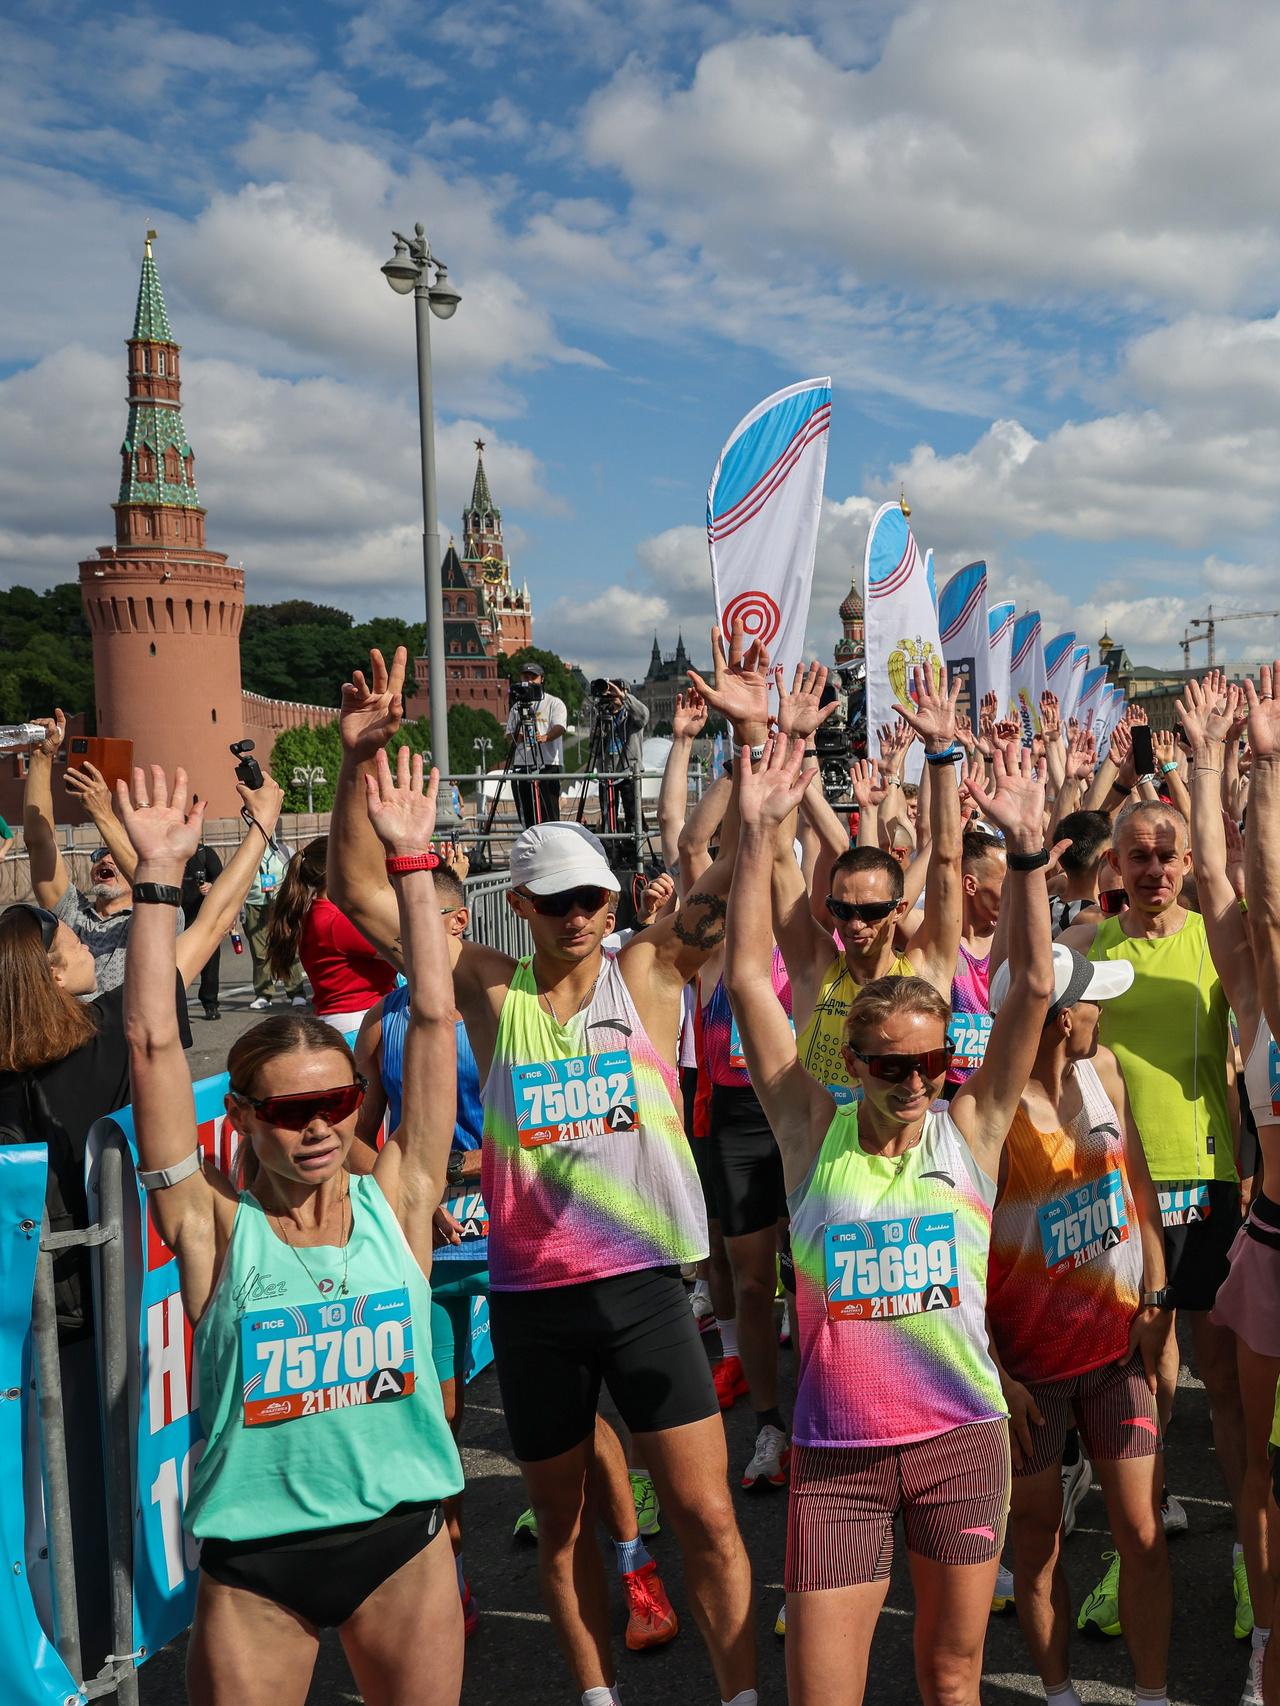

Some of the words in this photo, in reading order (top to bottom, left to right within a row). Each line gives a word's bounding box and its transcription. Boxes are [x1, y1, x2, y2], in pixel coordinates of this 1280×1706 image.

[526, 1071, 542, 1079] ПСБ
[523, 1073, 631, 1125] 75082
[558, 1117, 605, 1141] 21.1KM
[611, 1107, 632, 1128] A
[1050, 1192, 1120, 1259] 75701
[1186, 1206, 1203, 1224] A
[461, 1219, 480, 1237] A
[839, 1233, 857, 1242] ПСБ
[1104, 1228, 1121, 1250] A
[834, 1240, 951, 1297] 75699
[870, 1292, 922, 1318] 21.1KM
[926, 1286, 949, 1310] A
[262, 1319, 285, 1330] ПСБ
[256, 1320, 405, 1394] 75700
[372, 1370, 402, 1399] A
[301, 1380, 368, 1416] 21.1KM
